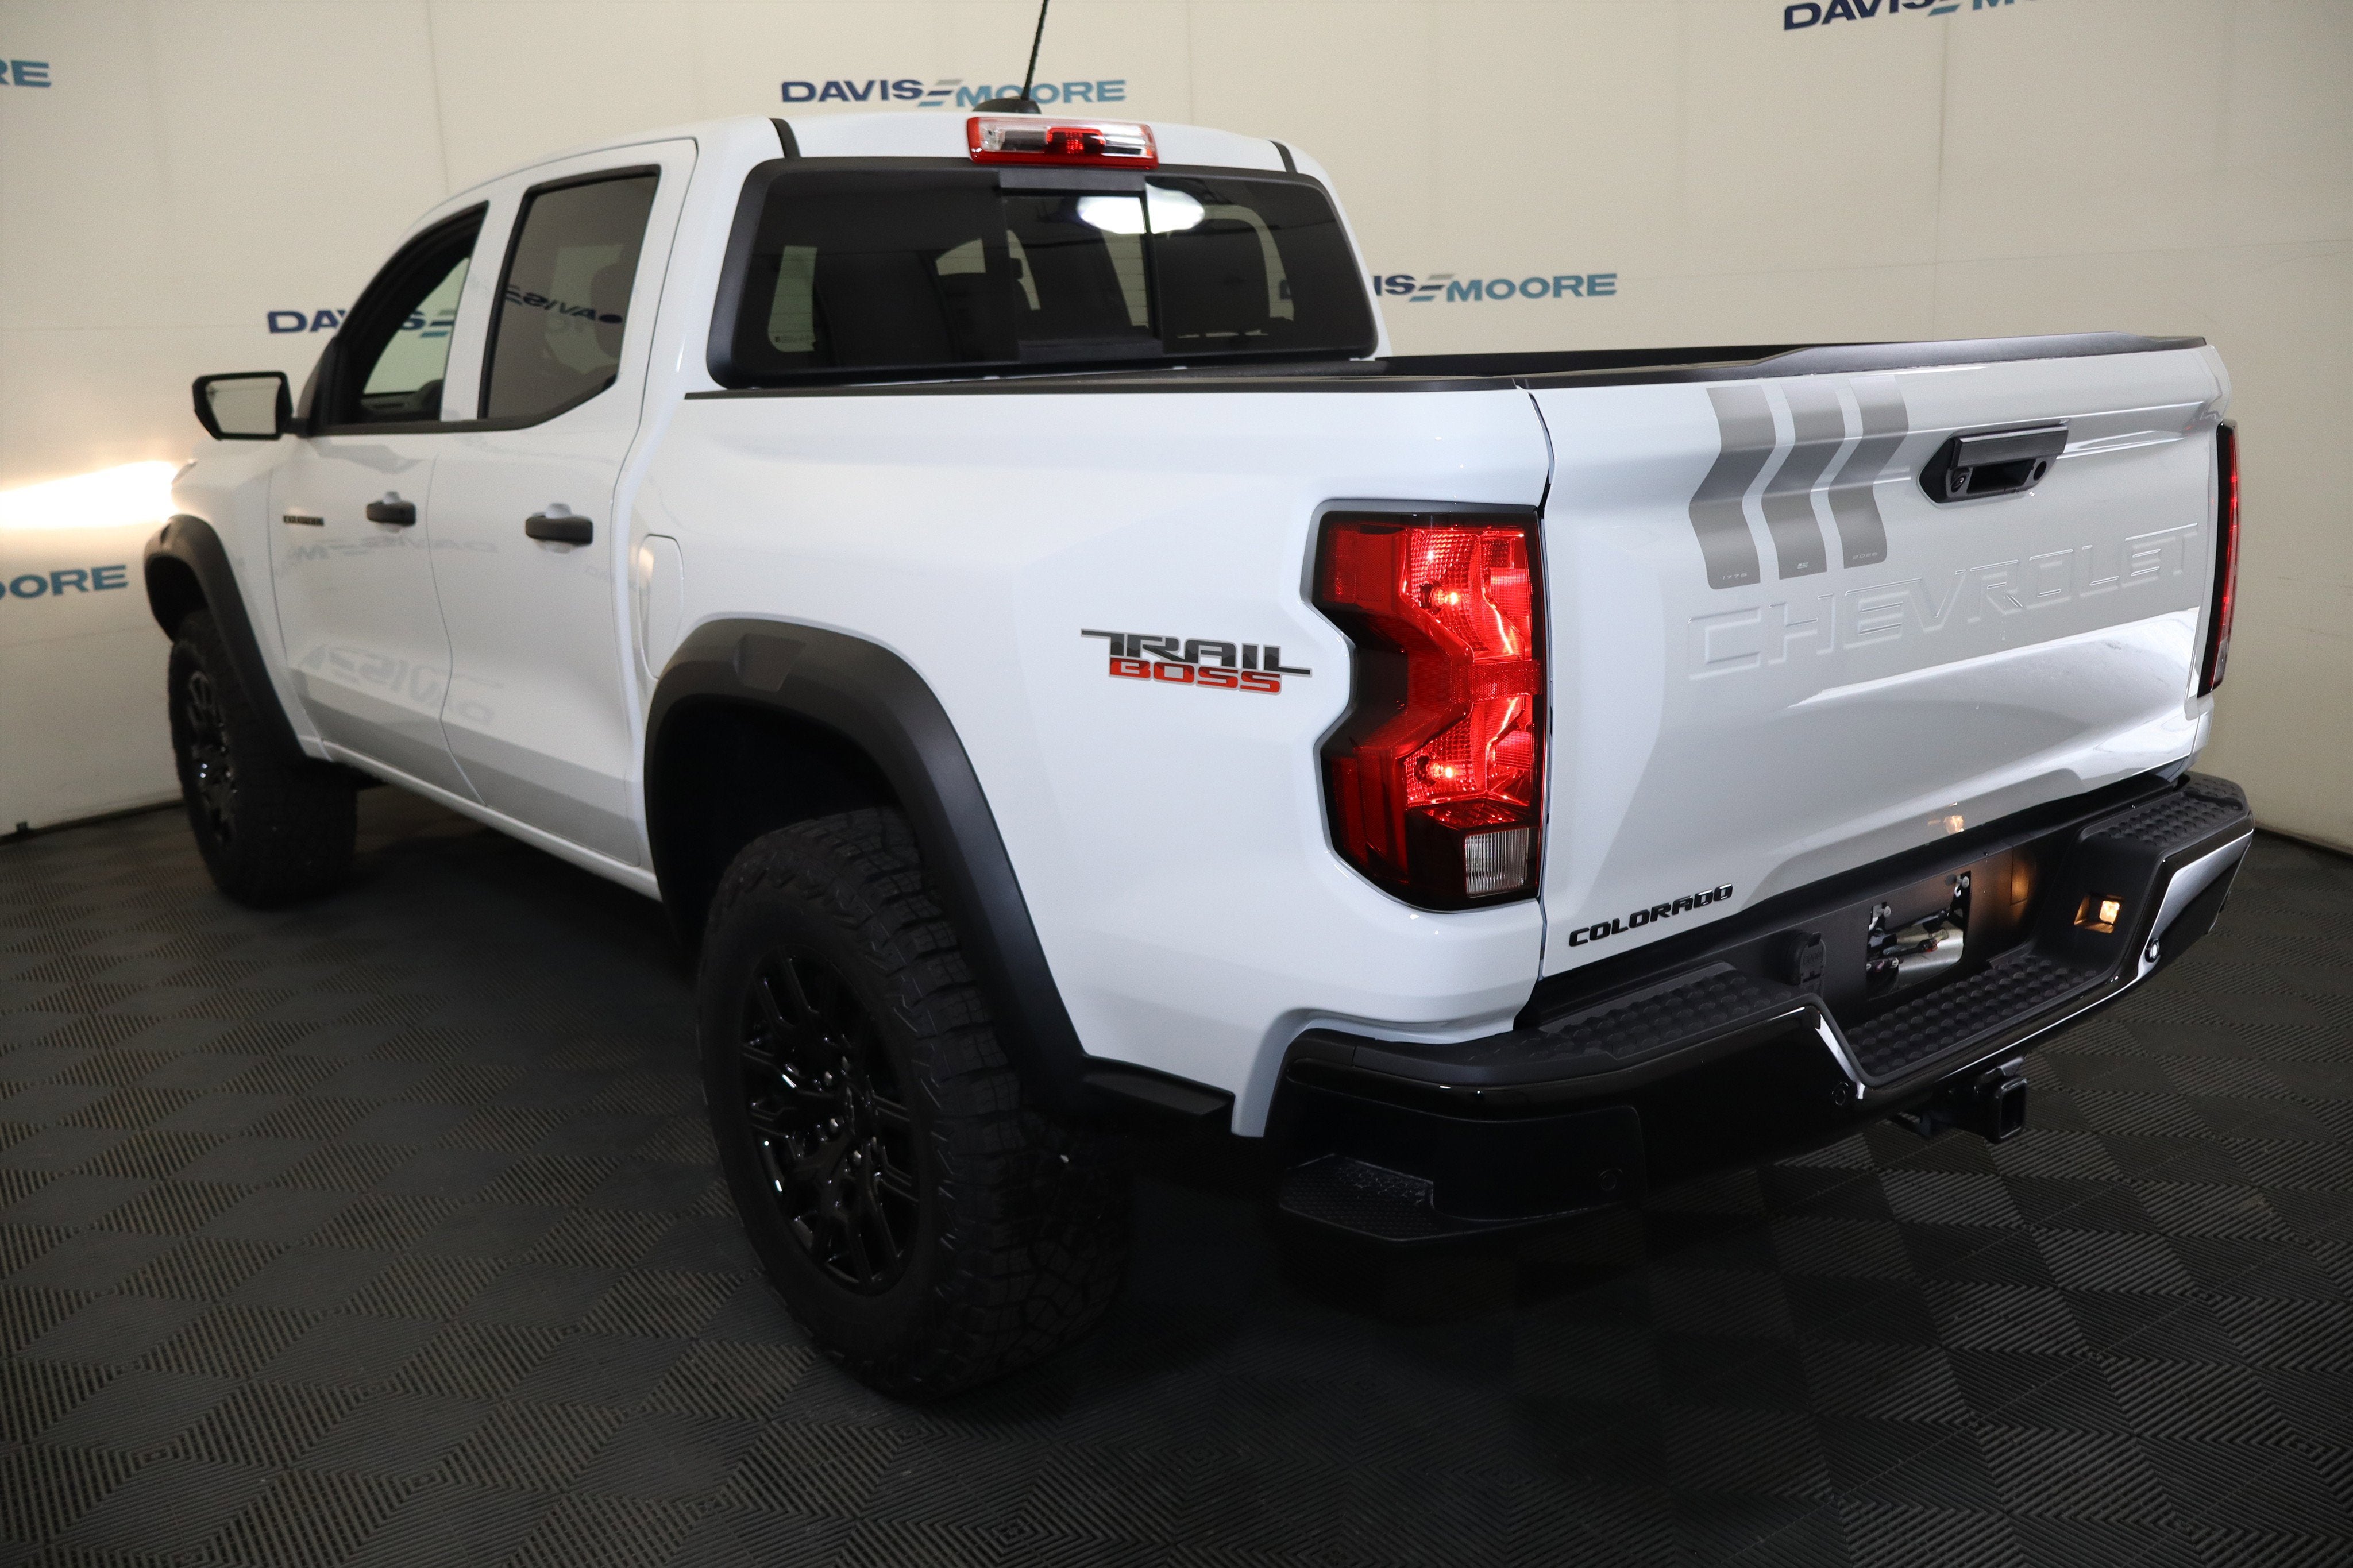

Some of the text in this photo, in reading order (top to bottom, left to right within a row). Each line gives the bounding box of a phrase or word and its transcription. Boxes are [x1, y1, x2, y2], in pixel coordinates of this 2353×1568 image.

[0, 60, 52, 87] E
[781, 79, 1126, 107] DAVIS MOORE
[1446, 273, 1617, 303] MOORE
[0, 564, 129, 600] ORE
[1688, 522, 2198, 681] CHEVROLET
[1081, 628, 1312, 678] TRAIL
[1109, 657, 1282, 696] BOSS
[1569, 883, 1733, 947] COLORADO
